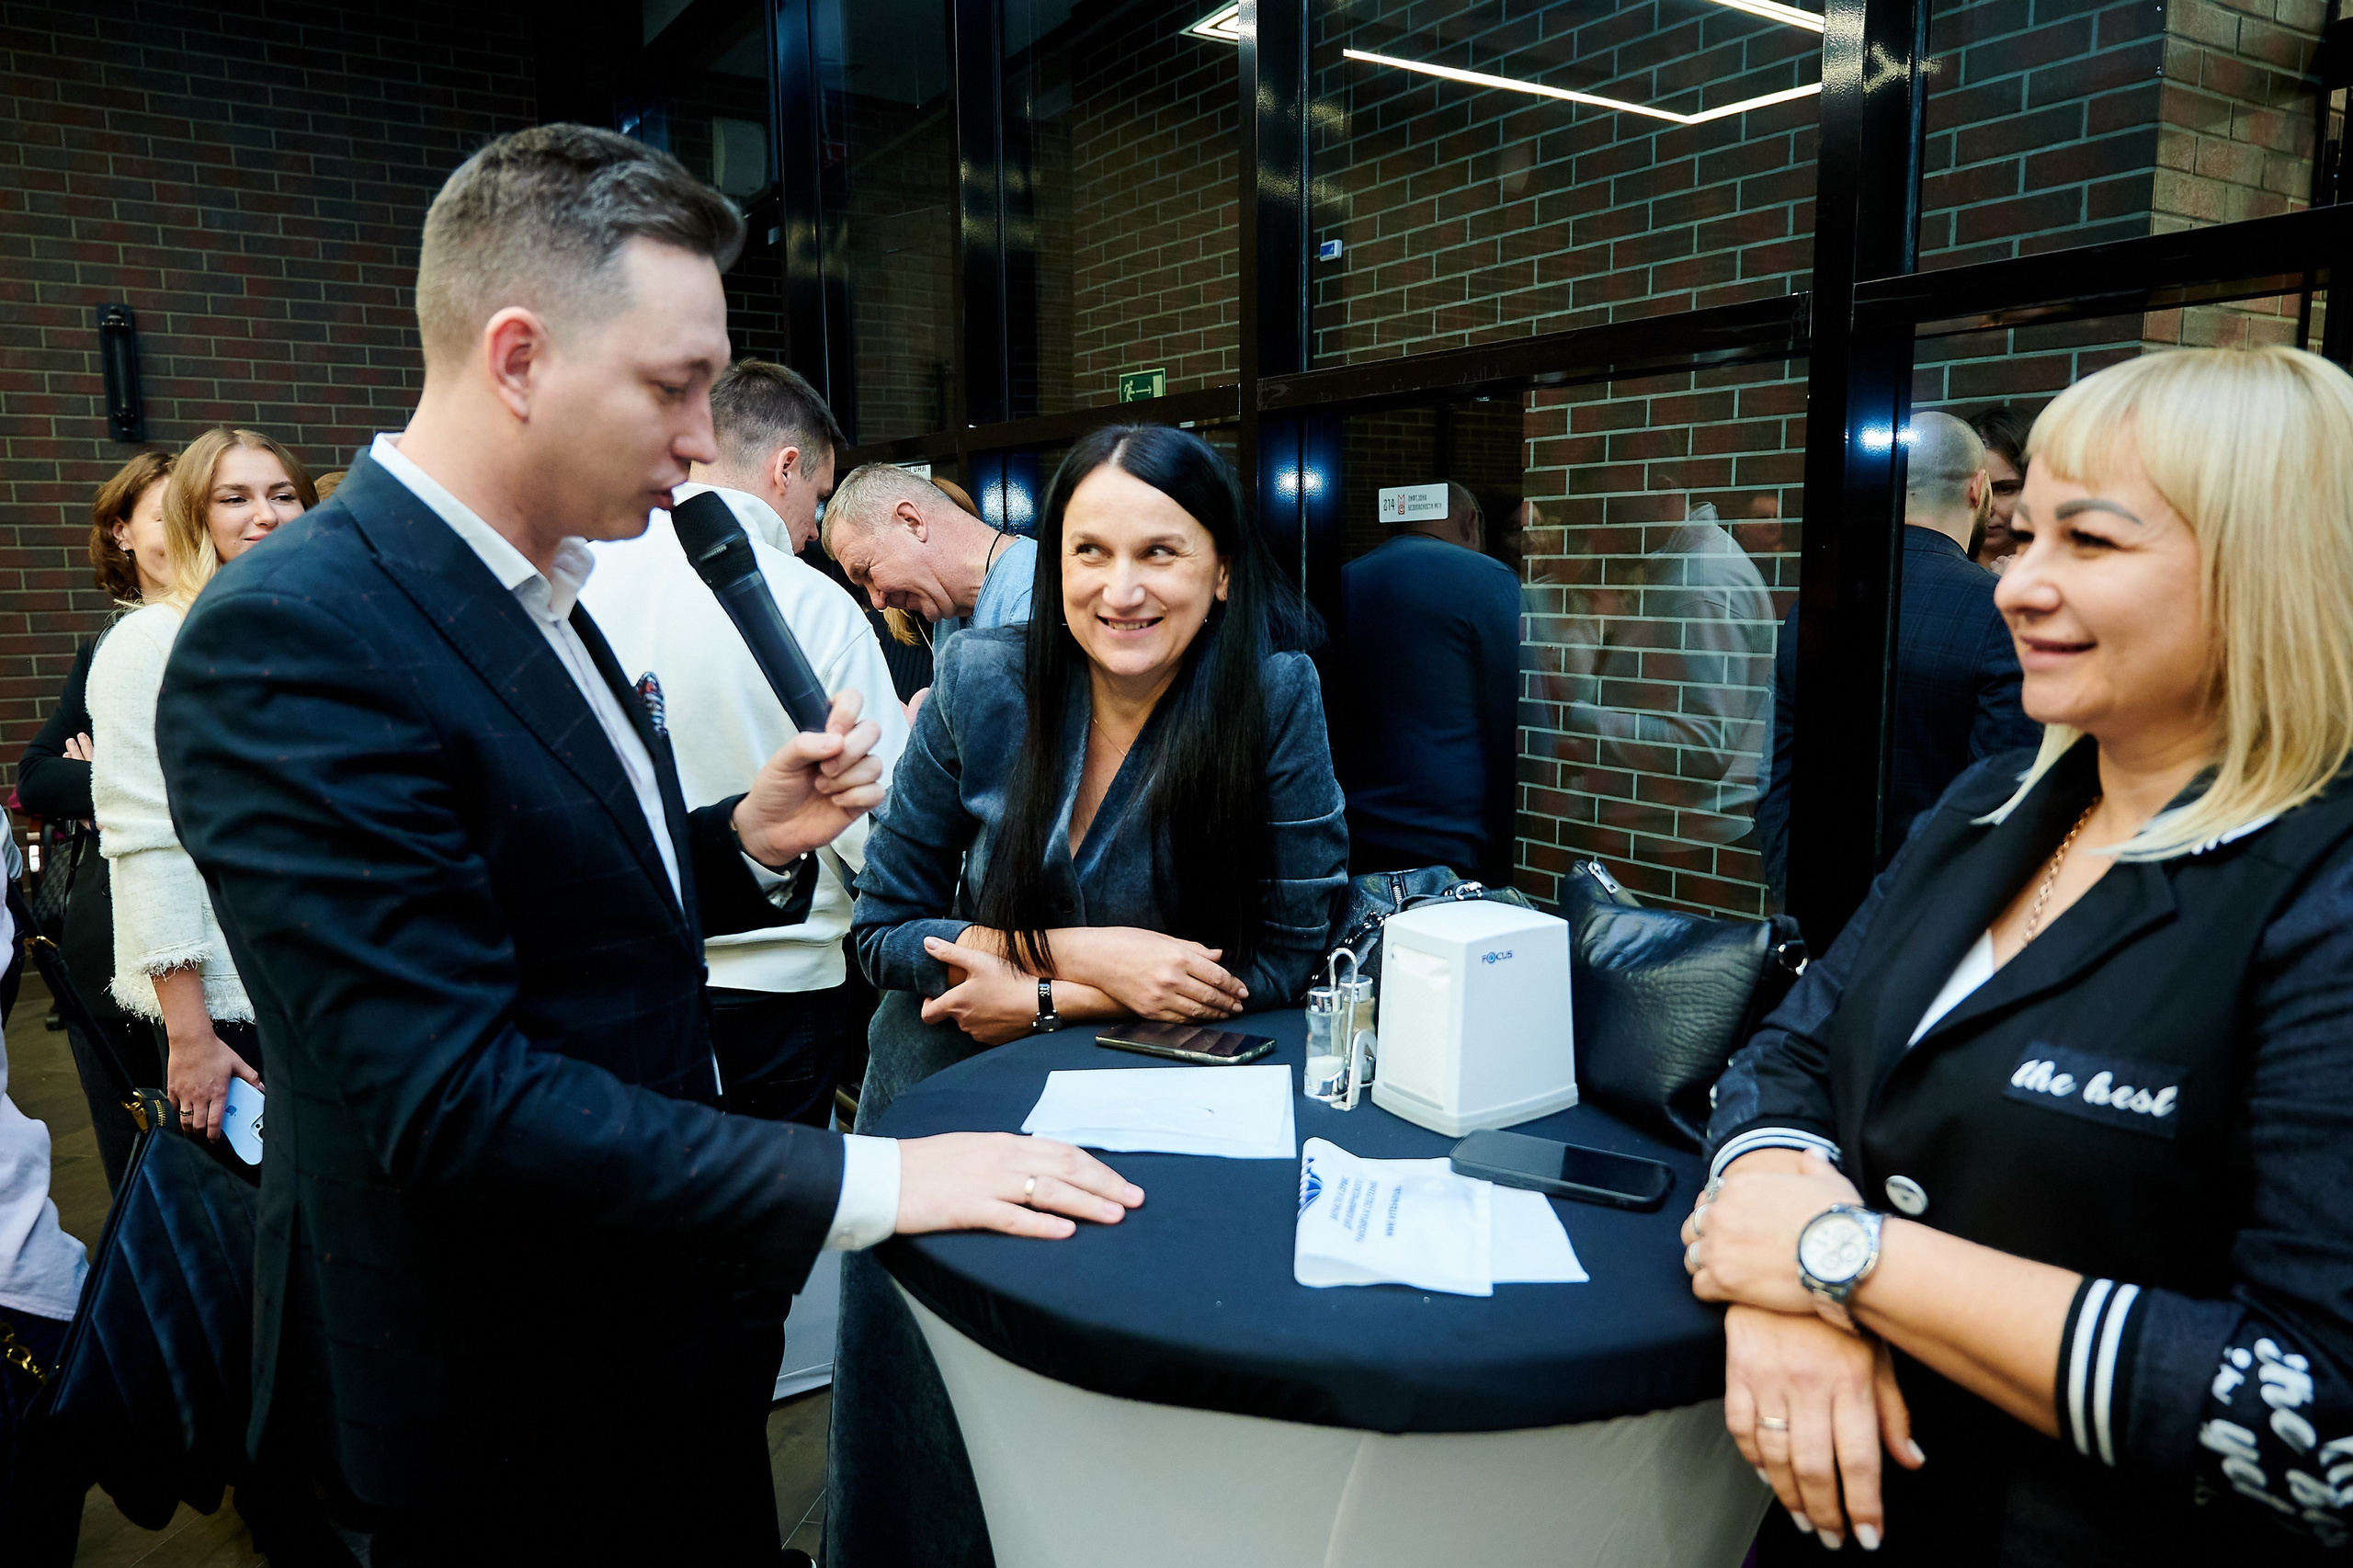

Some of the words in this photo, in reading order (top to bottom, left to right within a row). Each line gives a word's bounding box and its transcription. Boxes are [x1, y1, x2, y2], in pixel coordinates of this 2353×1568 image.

[1383, 498, 1395, 511] 214
[1481, 949, 1514, 964] FOCUS
[2010, 1058, 2078, 1097] the
[2082, 1070, 2179, 1118] best
